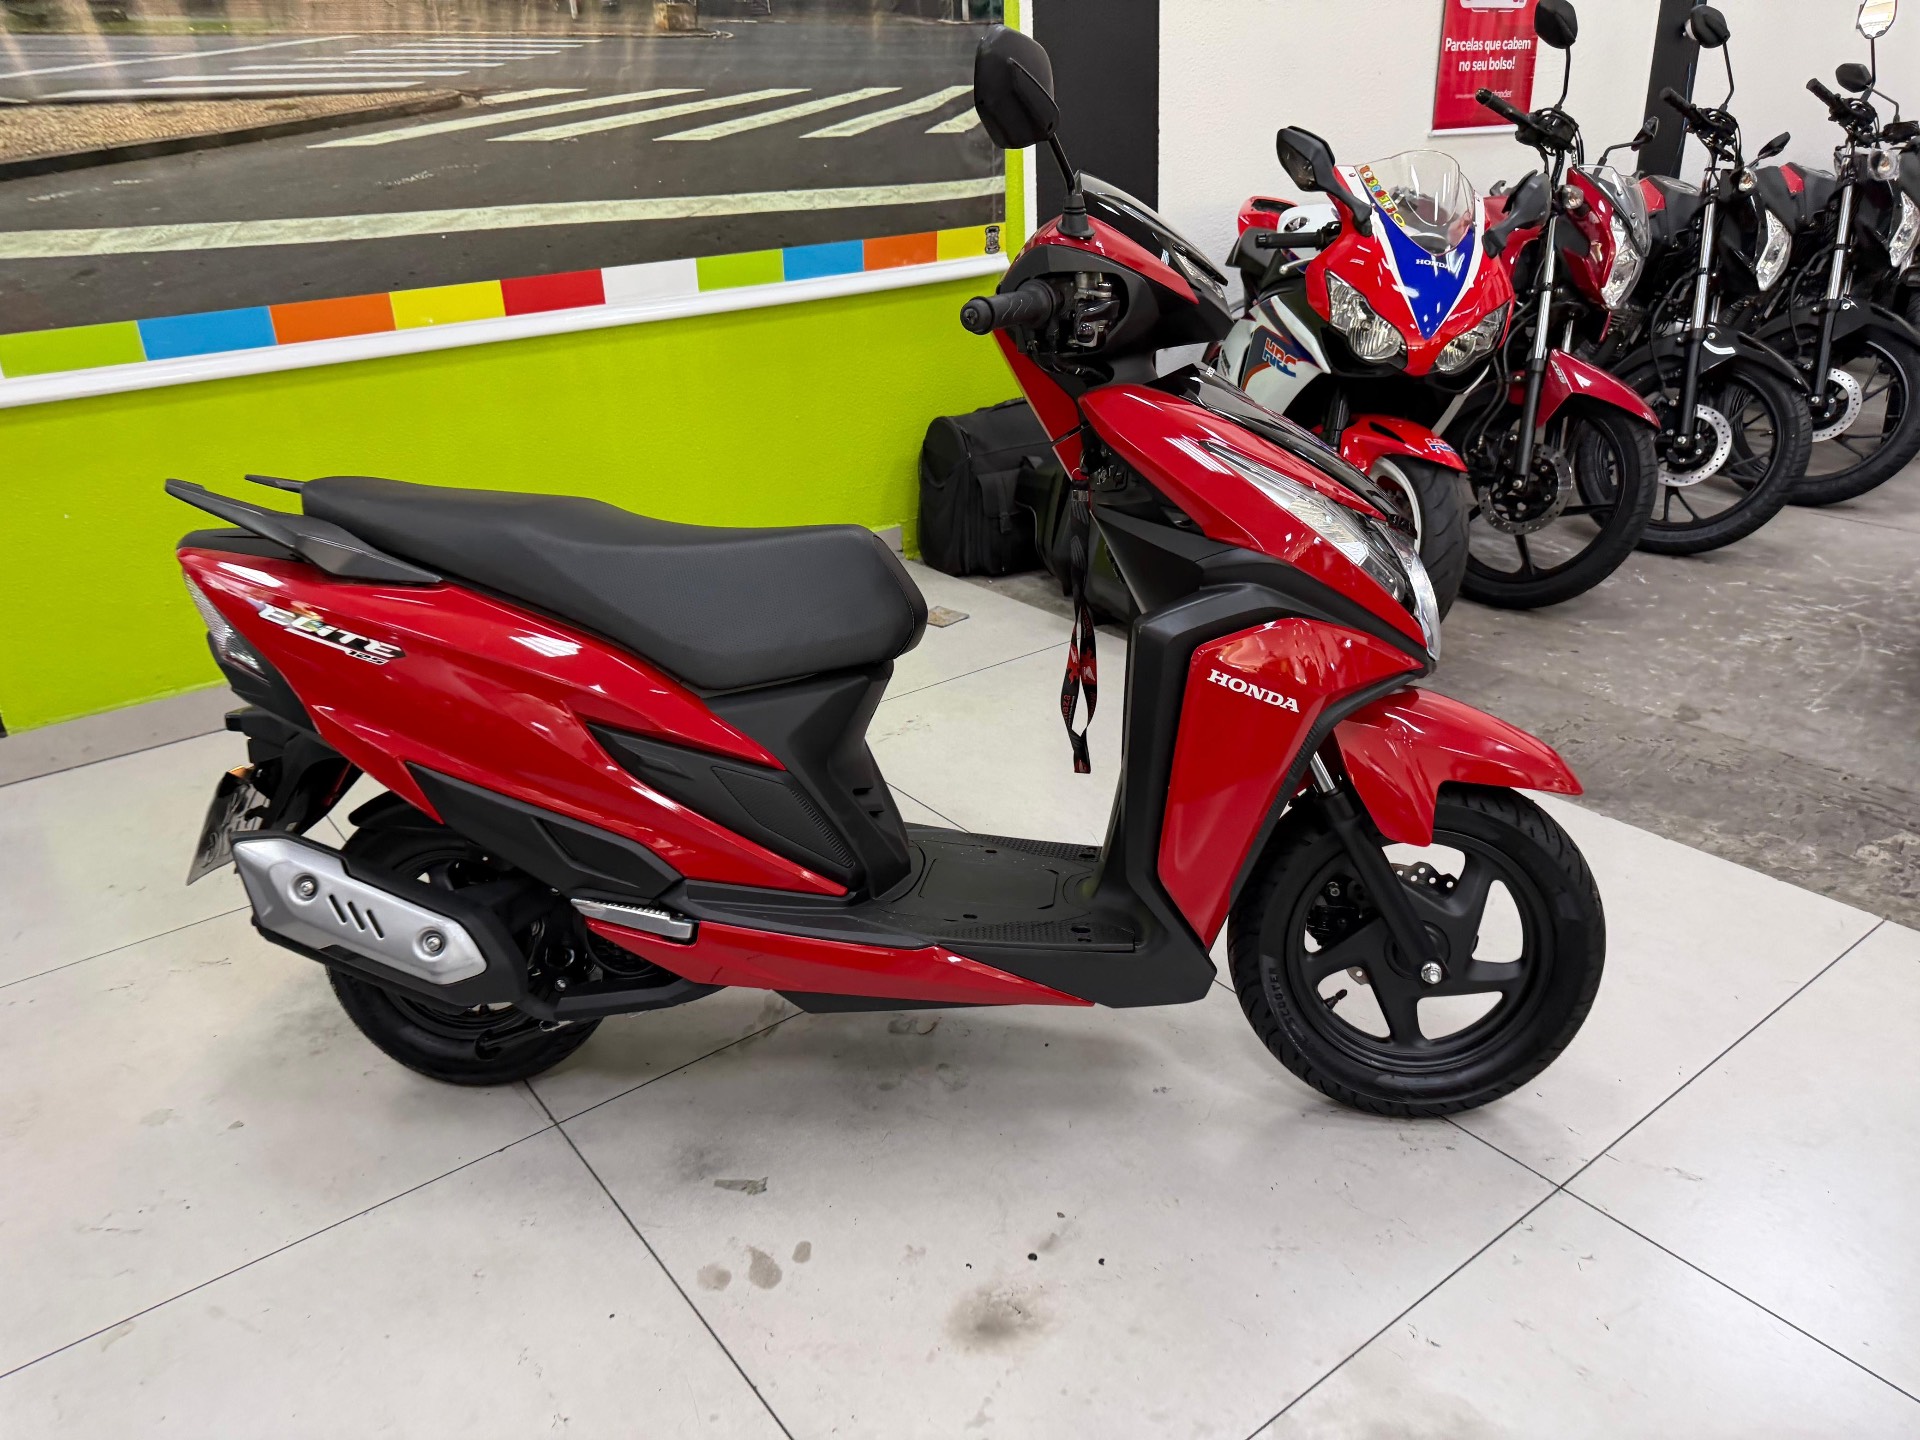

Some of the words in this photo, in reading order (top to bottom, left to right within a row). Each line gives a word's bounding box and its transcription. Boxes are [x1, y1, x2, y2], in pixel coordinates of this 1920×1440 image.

[1445, 37, 1483, 51] Parcelas
[1484, 40, 1501, 54] que
[1502, 37, 1531, 50] cabem
[1459, 60, 1471, 71] no
[1472, 60, 1487, 71] seu
[1488, 56, 1515, 71] bolso!
[1262, 337, 1297, 378] HRC
[1206, 668, 1300, 713] HONDA
